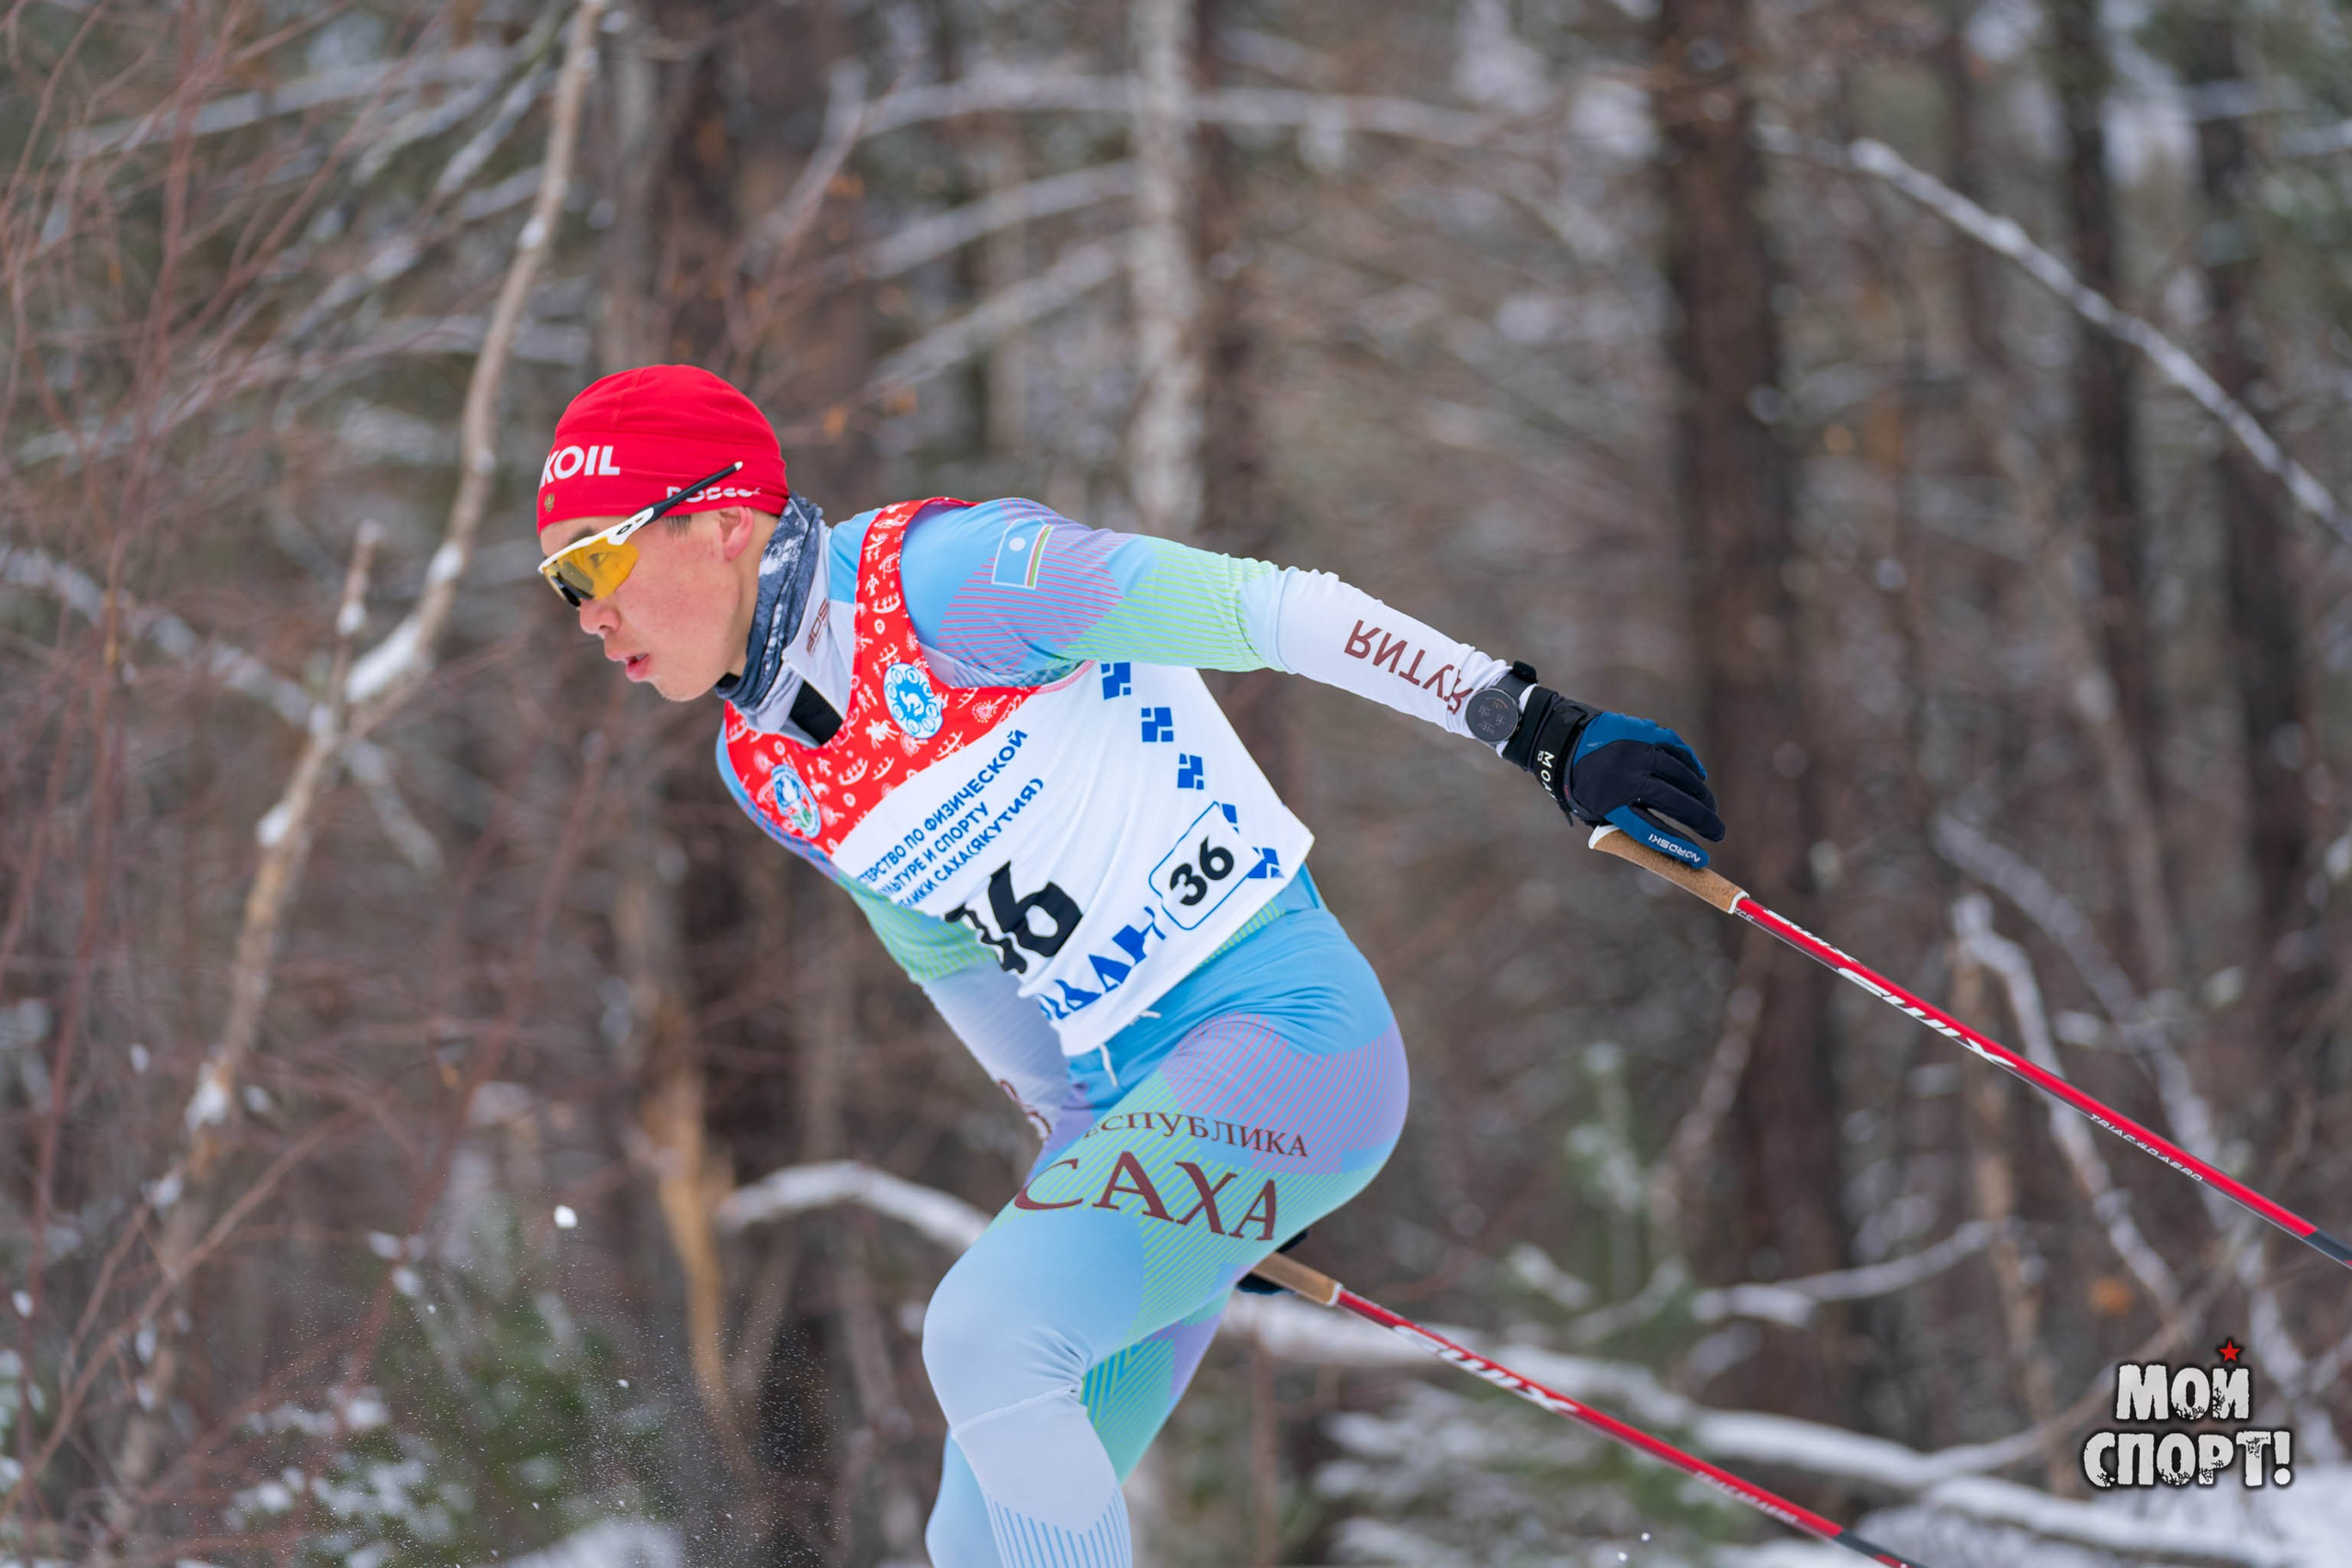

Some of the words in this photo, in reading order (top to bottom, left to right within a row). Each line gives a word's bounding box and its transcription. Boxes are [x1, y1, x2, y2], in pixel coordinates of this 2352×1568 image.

[857, 845, 907, 883] ТЕРСТВО
[904, 829, 924, 850] ПО
[924, 728, 1028, 830] ФИЗИЧЕСКОЙ
[877, 857, 926, 896] УЛЬТУРЕ
[922, 848, 937, 863] И
[934, 802, 989, 853] СПОРТУ
[1648, 833, 1702, 863] NORDSKI
[1170, 835, 1235, 907] 36
[1014, 1150, 1277, 1241] САХА
